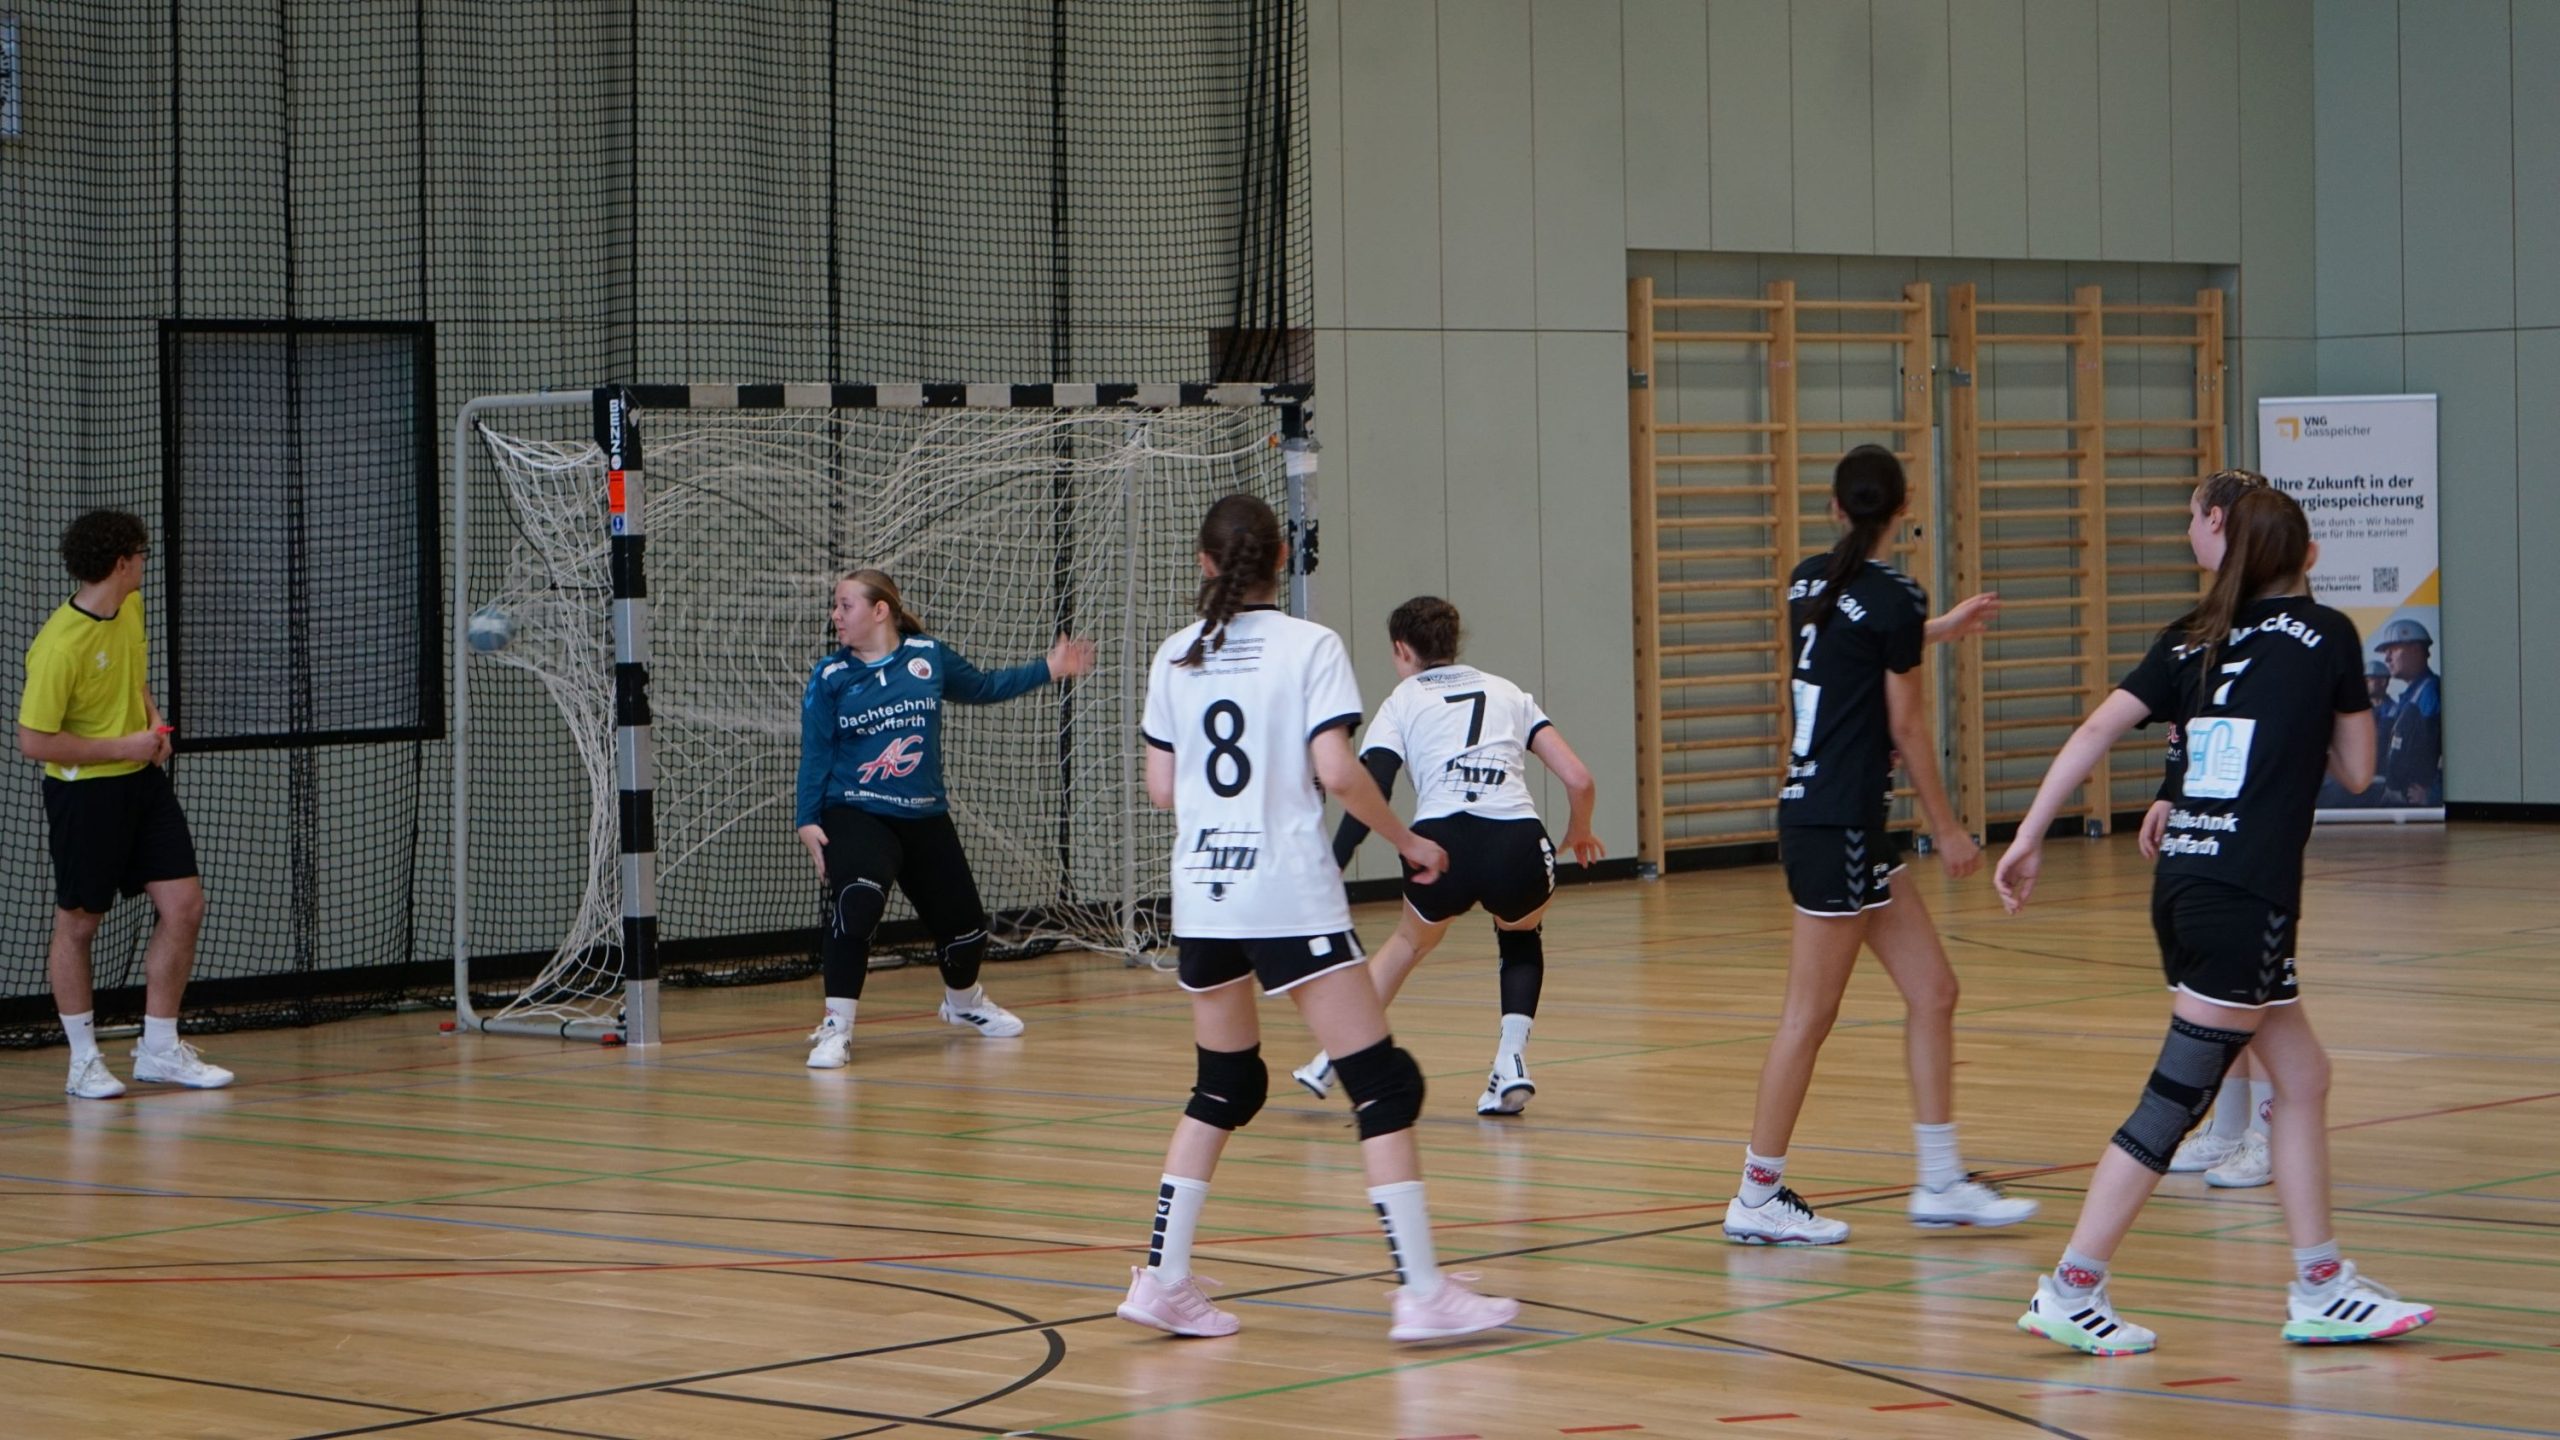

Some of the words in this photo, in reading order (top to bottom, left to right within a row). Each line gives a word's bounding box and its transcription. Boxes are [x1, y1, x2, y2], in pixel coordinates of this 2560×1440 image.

[2304, 416, 2328, 427] VNG
[2304, 425, 2371, 438] Gasspeicher
[2274, 476, 2303, 490] Ihre
[2307, 475, 2366, 490] Zukunft
[2370, 474, 2384, 489] in
[2388, 474, 2414, 489] der
[2296, 493, 2424, 511] rgiespeicherung
[2329, 517, 2356, 528] durch
[2366, 517, 2381, 526] Wir
[2384, 516, 2415, 526] haben
[2330, 529, 2344, 538] für
[2346, 528, 2365, 537] Ihre
[2367, 527, 2408, 538] Karriere!
[1798, 623, 1817, 670] 2
[875, 668, 887, 687] 1
[2213, 658, 2252, 705] 7
[839, 697, 937, 729] Dachtechnik
[1443, 690, 1487, 749] 7
[1203, 699, 1251, 798] 8
